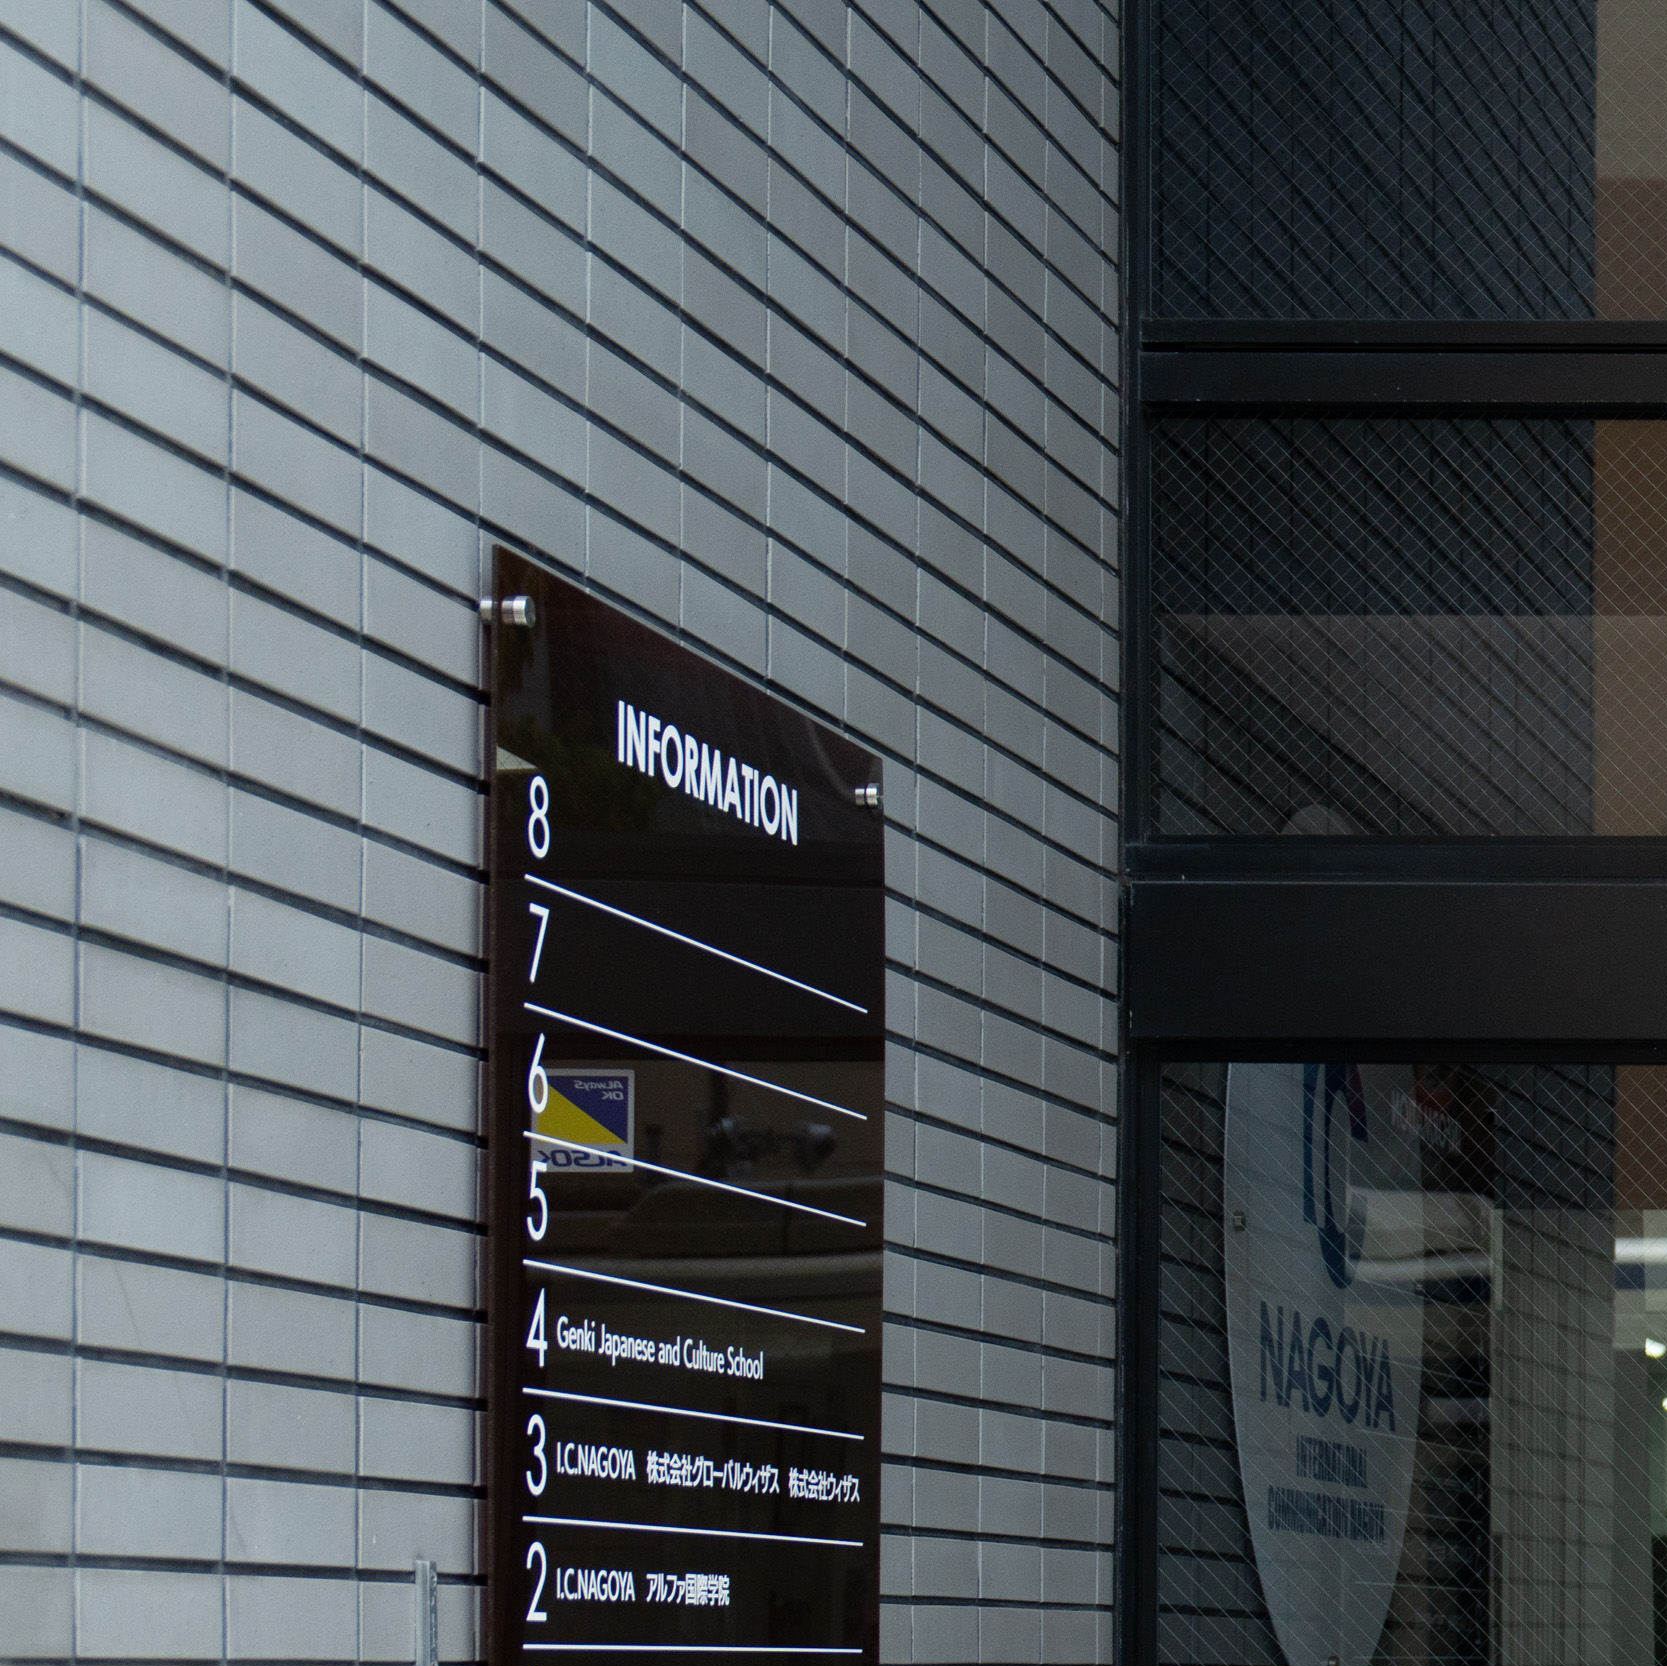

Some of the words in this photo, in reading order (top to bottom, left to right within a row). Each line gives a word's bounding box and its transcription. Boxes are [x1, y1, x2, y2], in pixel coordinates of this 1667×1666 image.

[617, 700, 798, 846] INFORMATION
[528, 775, 550, 860] 8
[528, 902, 550, 984] 7
[527, 1032, 549, 1114] 6
[526, 1160, 549, 1241] 5
[526, 1287, 548, 1368] 4
[556, 1315, 596, 1353] Genki
[598, 1323, 655, 1367] Japanese
[658, 1335, 681, 1367] and
[683, 1338, 725, 1374] Culture
[727, 1345, 764, 1380] School
[1260, 1299, 1396, 1433] NAGOYA
[525, 1413, 547, 1496] 3
[556, 1442, 636, 1480] I.C.NAGOYA
[646, 1450, 780, 1494] 株式会社グローバルウィザス
[788, 1467, 860, 1502] 株式会社ウィザス
[1296, 1434, 1368, 1489] INTERNATIONAL
[525, 1541, 548, 1622] 2
[556, 1567, 636, 1602] I.C.NAGOYA
[645, 1573, 730, 1607] アルファ国際学院
